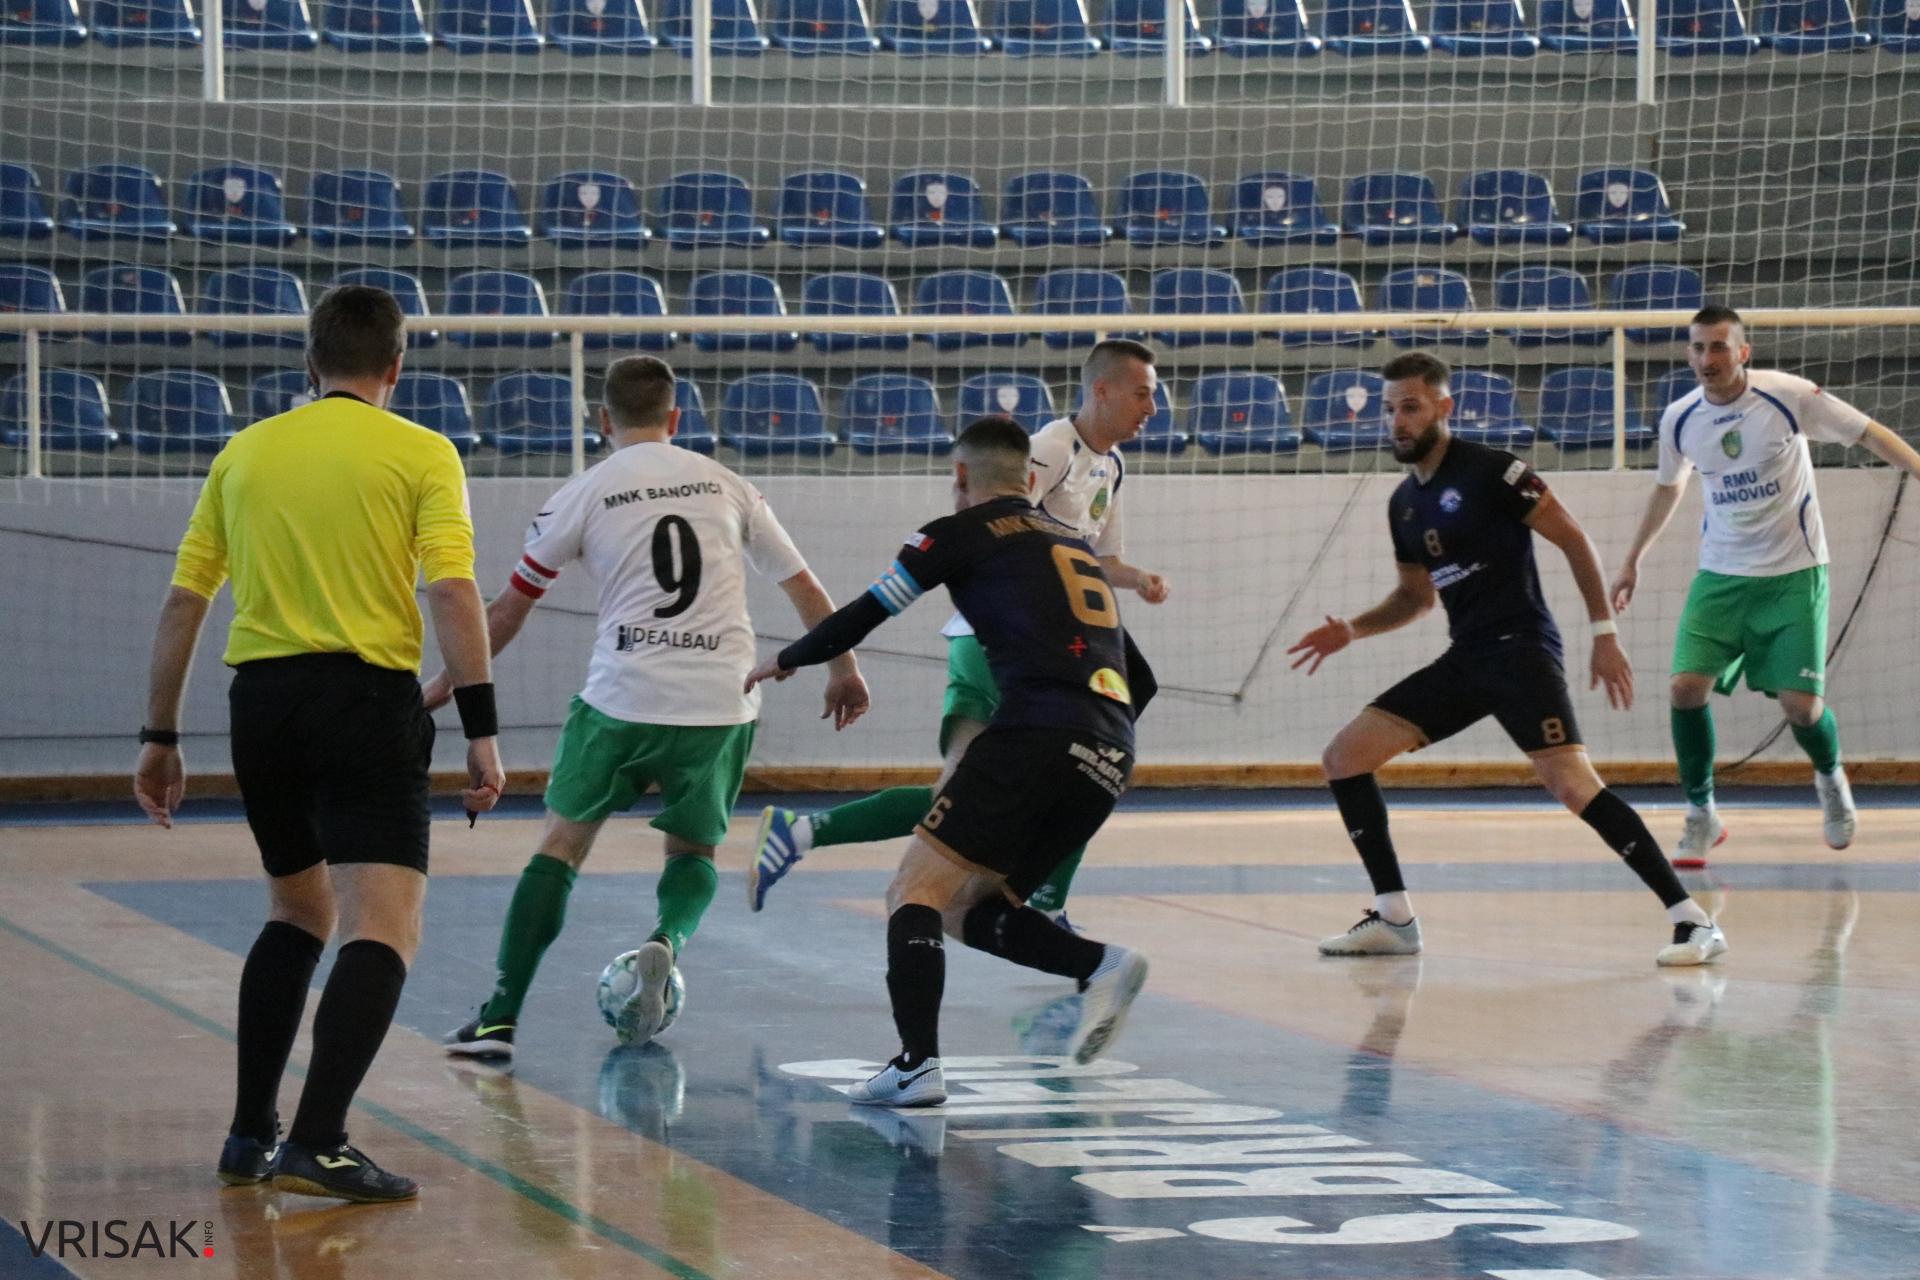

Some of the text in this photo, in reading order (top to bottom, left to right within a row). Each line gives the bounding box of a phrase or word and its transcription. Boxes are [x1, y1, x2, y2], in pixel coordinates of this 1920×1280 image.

[1723, 470, 1757, 489] RMU
[603, 489, 642, 510] MNK
[1424, 528, 1442, 557] 8
[652, 514, 702, 619] 9
[1052, 544, 1120, 629] 6
[626, 627, 720, 651] IDEALBAU
[1541, 717, 1567, 745] 8
[923, 796, 952, 830] 6
